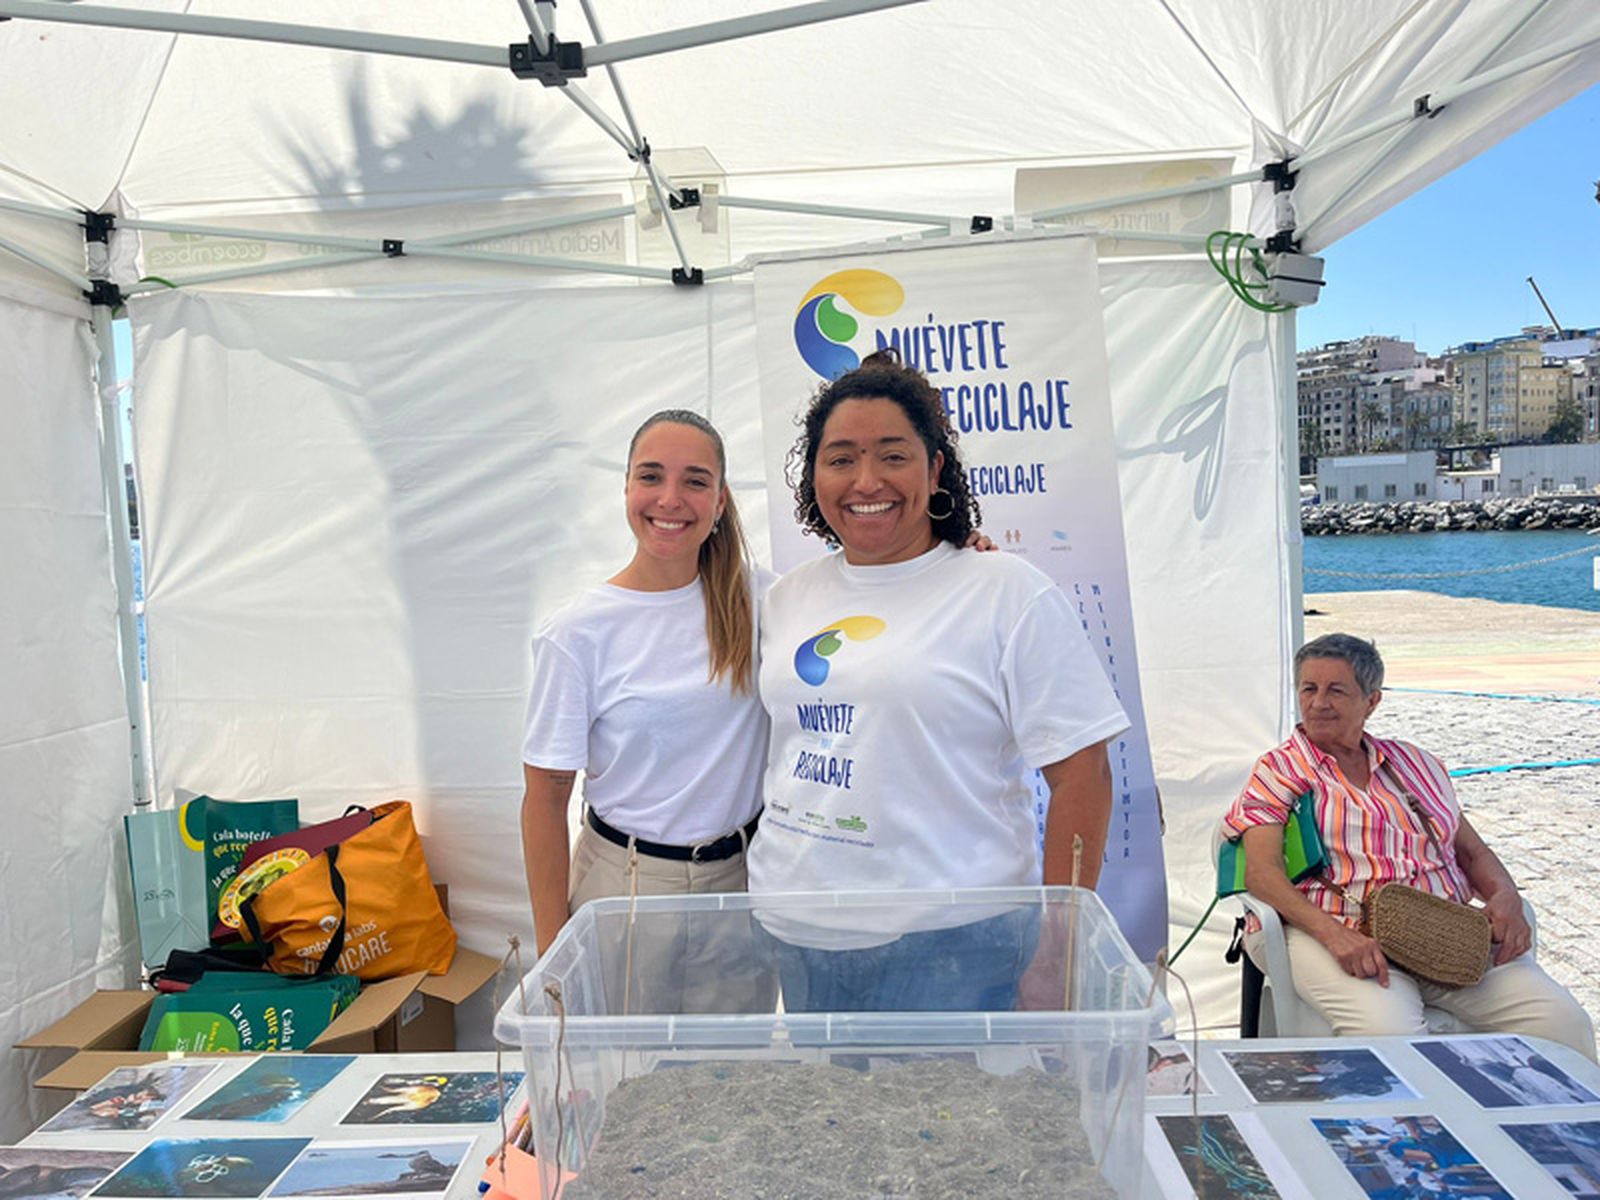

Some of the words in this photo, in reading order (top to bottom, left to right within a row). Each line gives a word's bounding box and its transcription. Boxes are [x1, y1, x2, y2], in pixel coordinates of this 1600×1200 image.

[875, 313, 1009, 373] MUÉVETE
[941, 379, 1074, 434] ECICLAJE
[969, 463, 1047, 497] ECICLAJE
[797, 697, 855, 735] MUÉVETE
[229, 1003, 243, 1020] la
[238, 1019, 253, 1046] que
[264, 1007, 279, 1035] que
[281, 1008, 295, 1044] Cada
